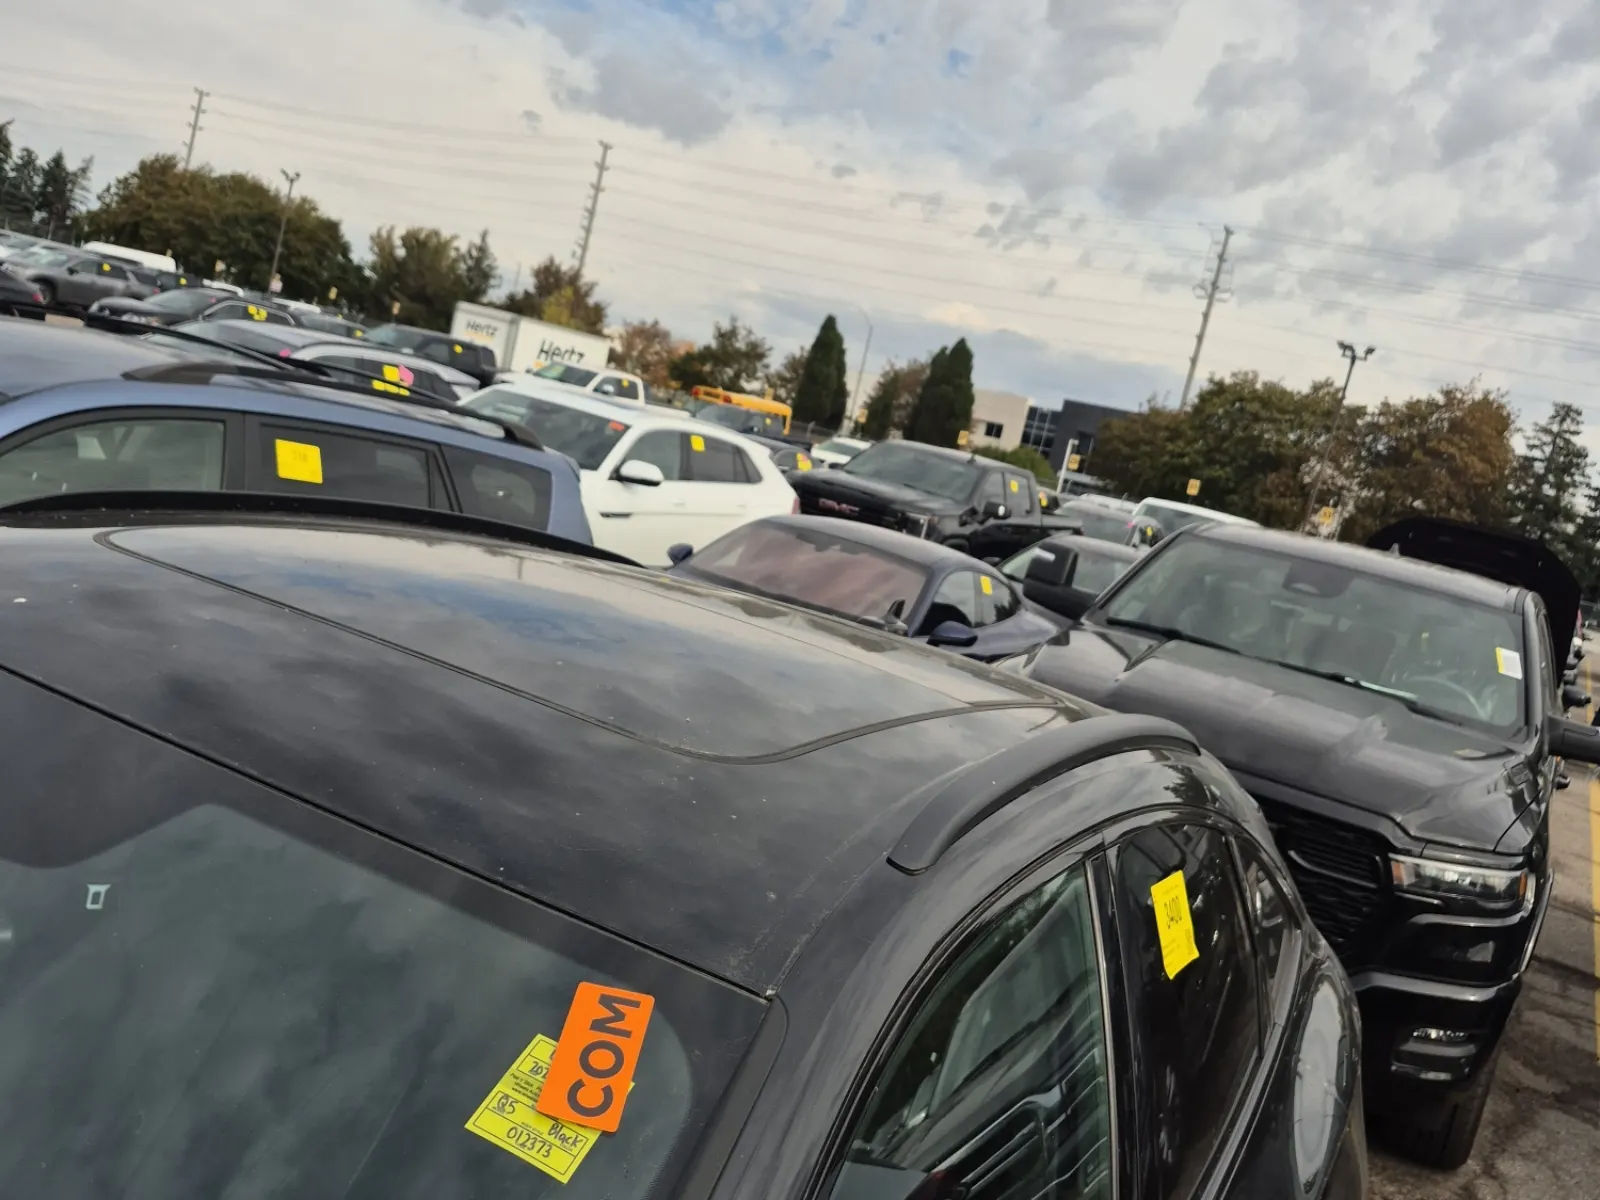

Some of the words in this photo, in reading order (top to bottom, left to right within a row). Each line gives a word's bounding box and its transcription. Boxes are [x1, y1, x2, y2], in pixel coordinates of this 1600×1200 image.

[466, 319, 499, 337] Hertz
[537, 340, 585, 363] Hertz
[567, 993, 642, 1117] COM
[497, 1093, 518, 1115] Q5
[506, 1126, 552, 1158] 012373
[548, 1122, 584, 1148] Black
